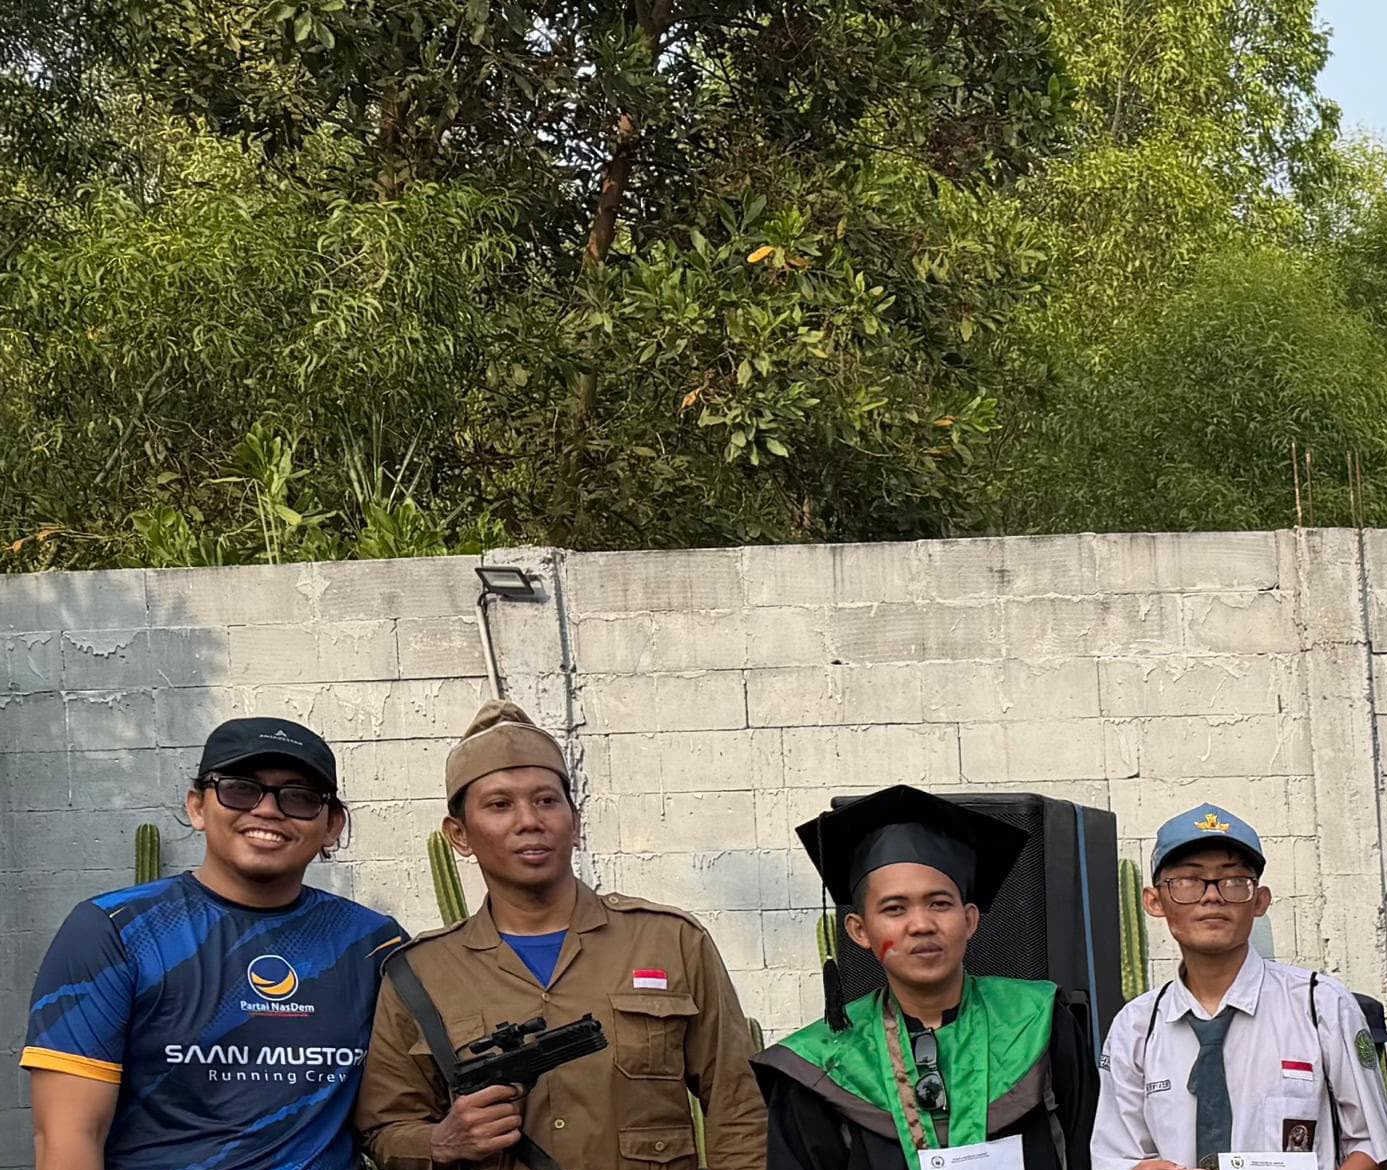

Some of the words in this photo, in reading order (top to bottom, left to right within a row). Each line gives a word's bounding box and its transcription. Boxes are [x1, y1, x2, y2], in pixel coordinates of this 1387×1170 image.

[271, 1002, 315, 1013] NasDem
[165, 1045, 249, 1064] SAAN
[209, 1070, 297, 1084] Running
